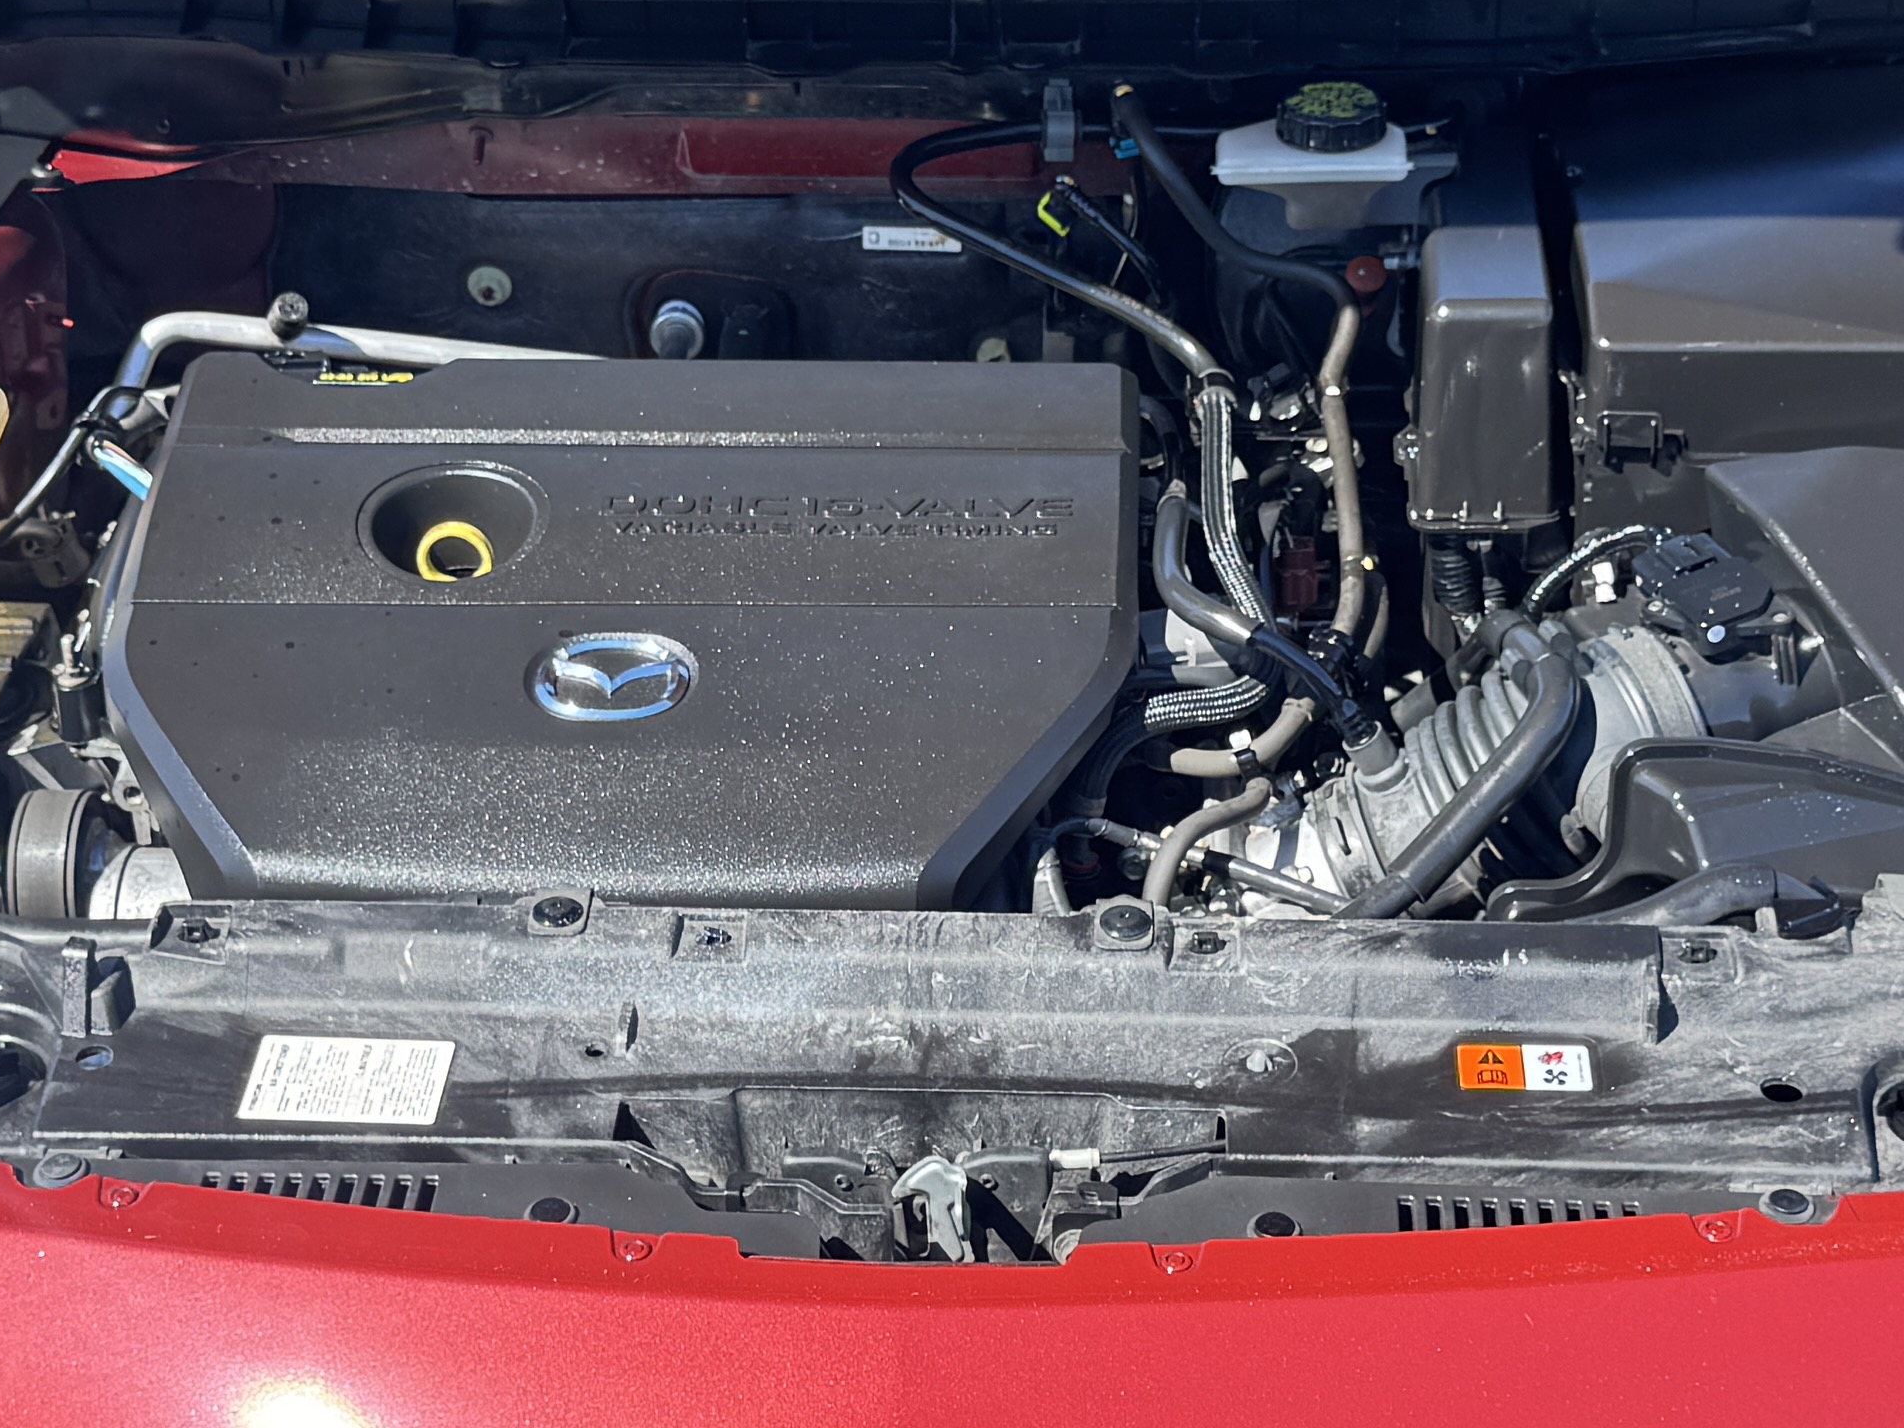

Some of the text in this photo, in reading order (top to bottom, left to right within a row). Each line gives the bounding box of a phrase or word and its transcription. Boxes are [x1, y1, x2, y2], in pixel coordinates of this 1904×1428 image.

[598, 495, 1075, 520] DOHC 16-VALVE
[613, 520, 1059, 538] VARIABLE VALVE TIMING
